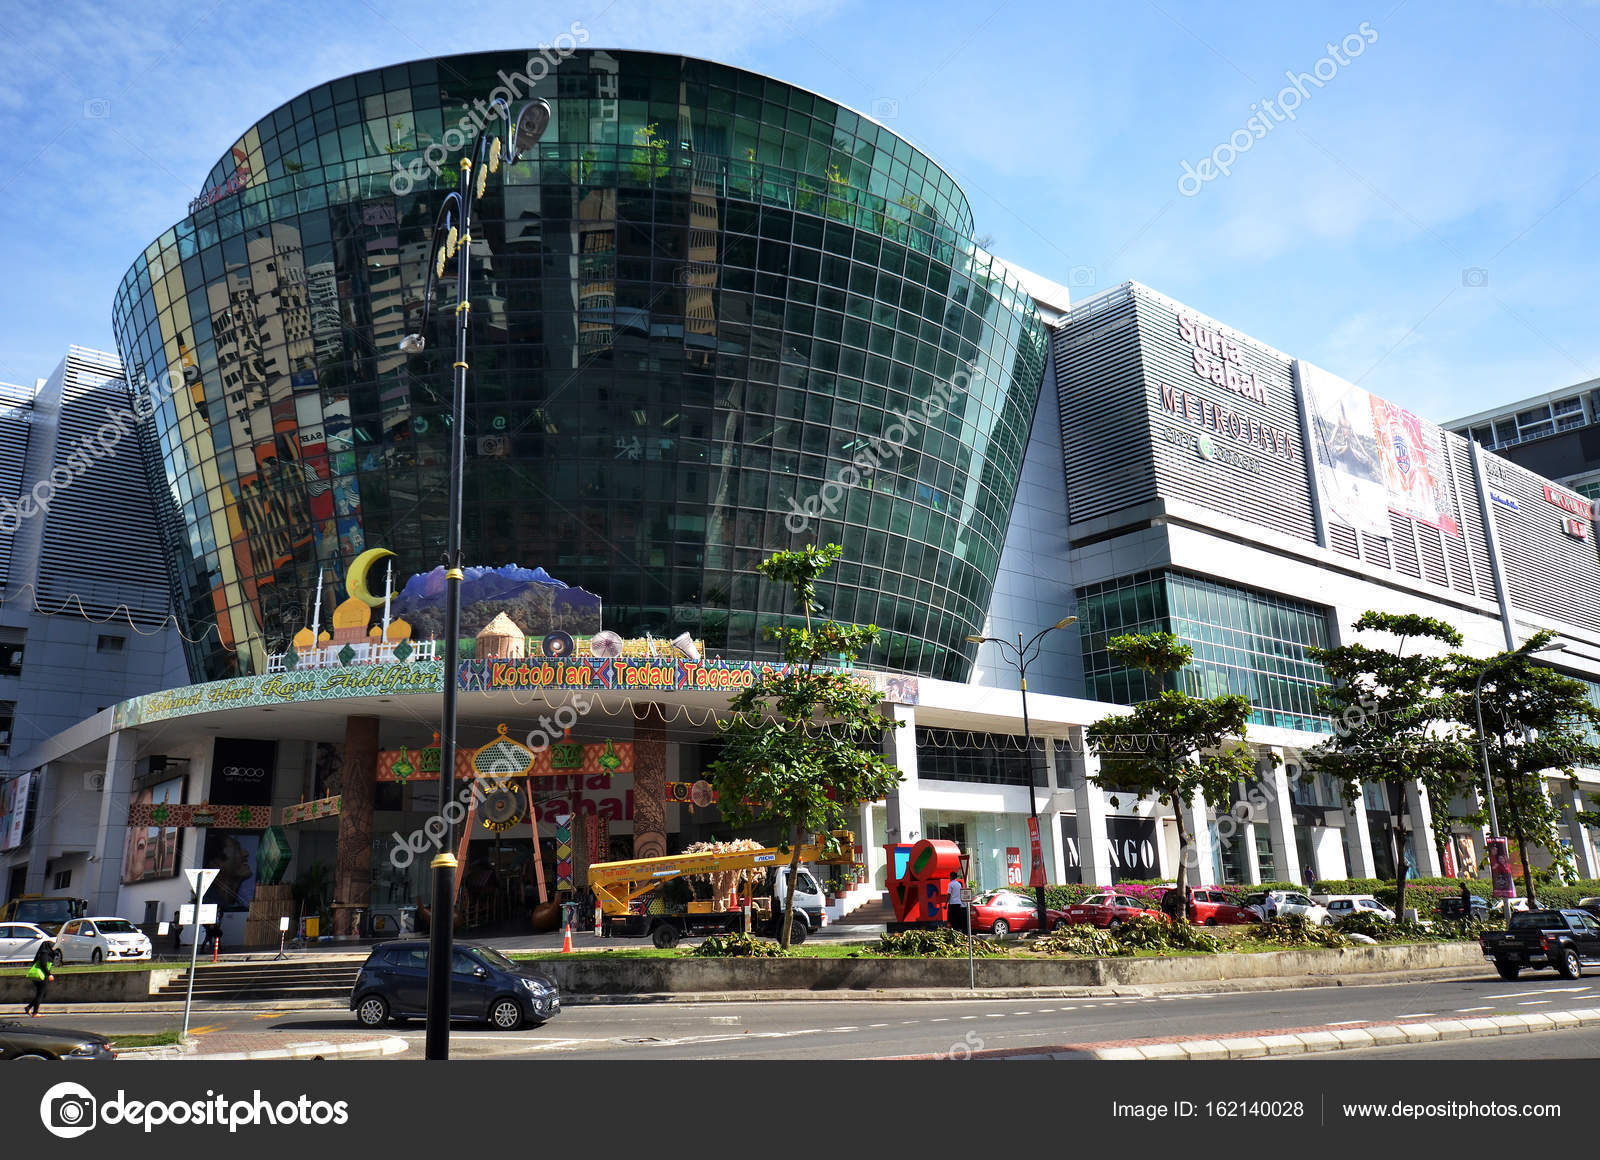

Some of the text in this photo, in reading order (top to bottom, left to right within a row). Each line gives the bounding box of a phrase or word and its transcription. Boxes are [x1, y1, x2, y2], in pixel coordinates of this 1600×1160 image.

[1177, 312, 1241, 366] Suria
[1193, 346, 1267, 406] Sabah
[1158, 382, 1296, 460] METROJAYA
[147, 664, 440, 714] Selamat Hari Raya Aidilfitri
[491, 662, 591, 687] Kotobian
[614, 662, 674, 686] Tadau
[684, 663, 753, 688] Tagazo
[1008, 868, 1021, 884] 50
[1067, 837, 1154, 869] MNGO
